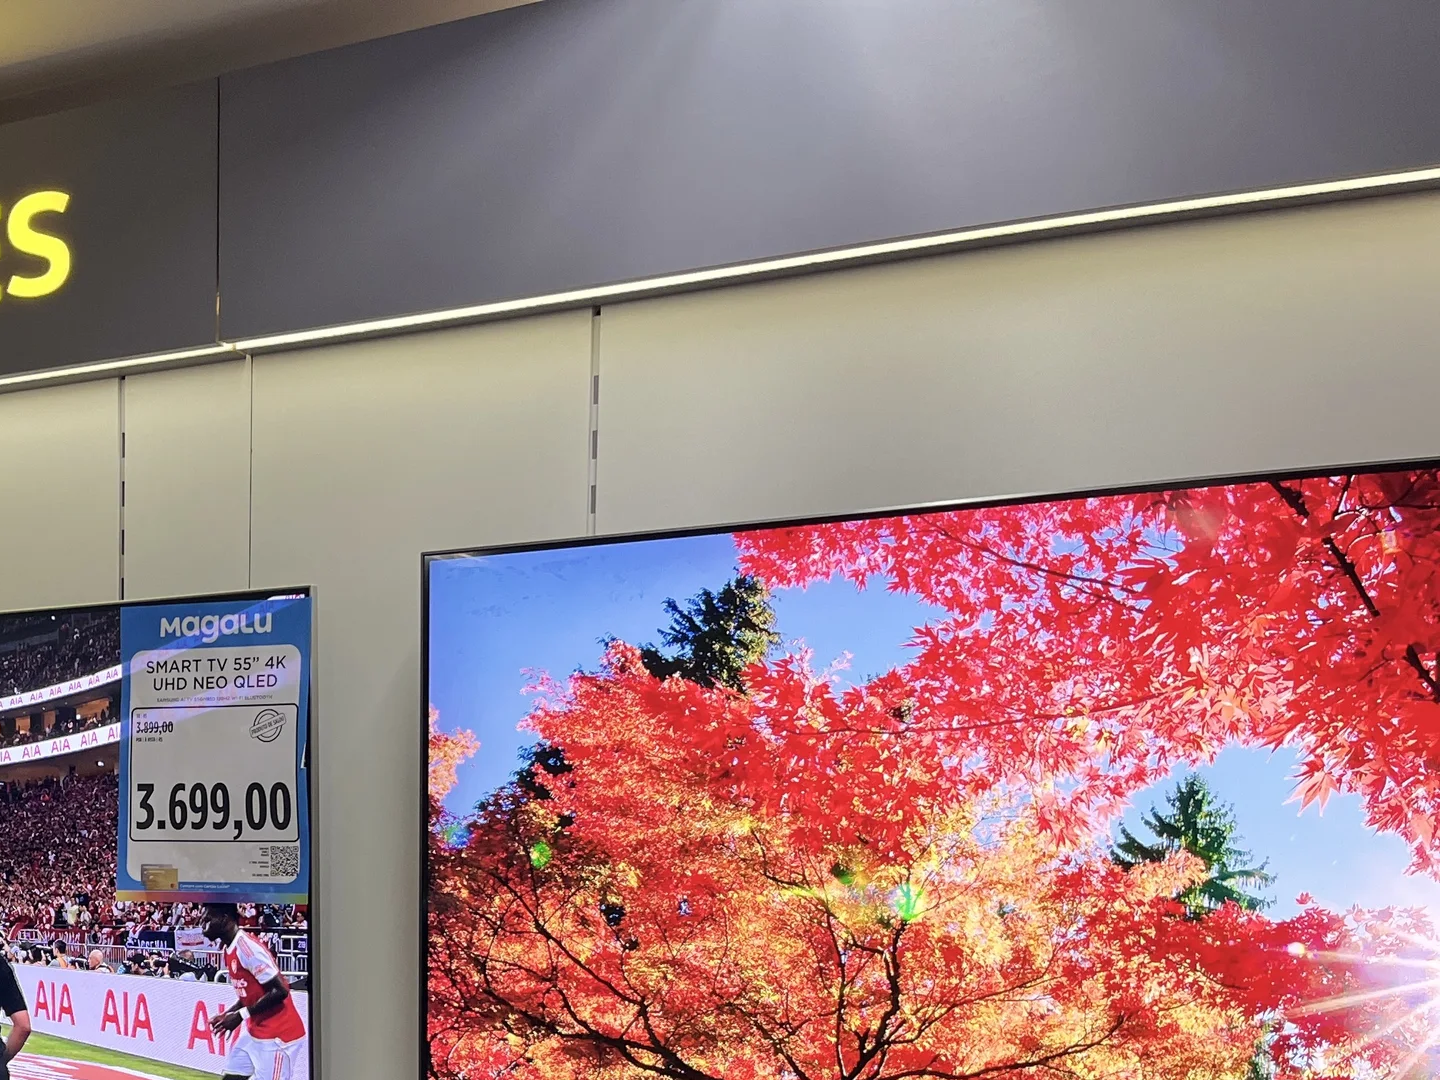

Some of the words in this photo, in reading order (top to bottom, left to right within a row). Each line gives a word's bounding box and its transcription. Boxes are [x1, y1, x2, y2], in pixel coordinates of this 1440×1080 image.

[160, 611, 273, 644] Magalu
[146, 658, 203, 674] SMART
[207, 657, 229, 672] TV
[265, 655, 287, 669] 4K
[153, 677, 188, 692] UHD
[193, 676, 228, 690] NEO
[233, 673, 278, 689] QLED
[136, 721, 174, 736] 3.899,00
[251, 722, 268, 735] PRODUTO
[81, 730, 99, 747] AIA
[135, 781, 292, 841] 3.699,00
[34, 980, 75, 1026] AIA
[100, 989, 154, 1042] AIA
